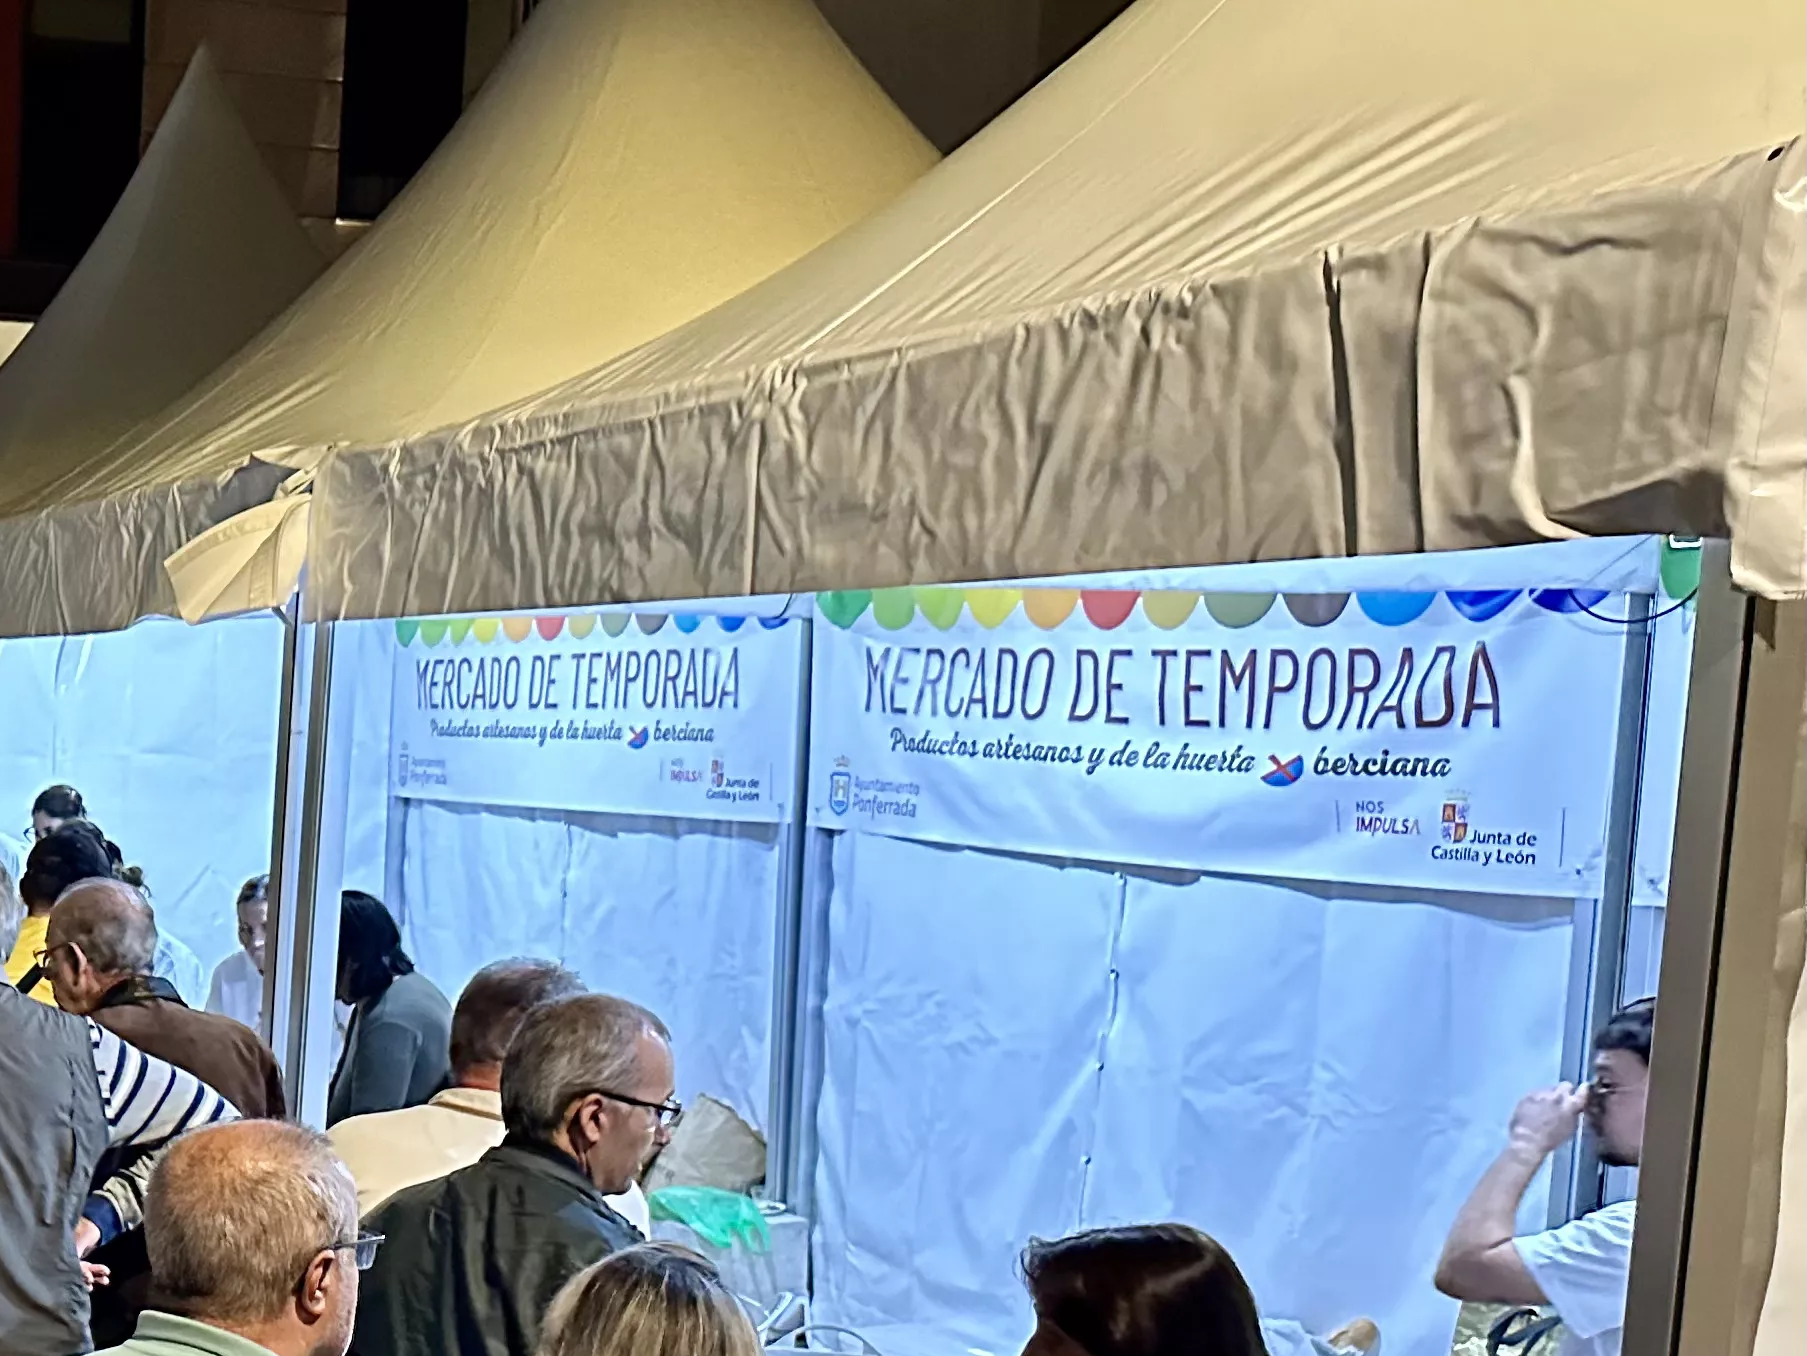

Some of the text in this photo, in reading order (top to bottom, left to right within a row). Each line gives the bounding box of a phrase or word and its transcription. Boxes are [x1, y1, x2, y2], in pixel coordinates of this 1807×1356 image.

[416, 647, 739, 710] MERCADO DE TEMPORADA
[864, 640, 1500, 730] MERCADO DE TEMPORADA
[430, 718, 714, 747] Productos artesanos y de la huerta berciana
[890, 727, 1453, 777] Productos artesanos y de la huerta berciana
[853, 793, 917, 820] Ponferrada
[1355, 801, 1384, 813] NOS
[1355, 816, 1421, 836] IMPULSA
[1469, 829, 1537, 846] Junta de
[1431, 845, 1536, 866] Castilla y León
